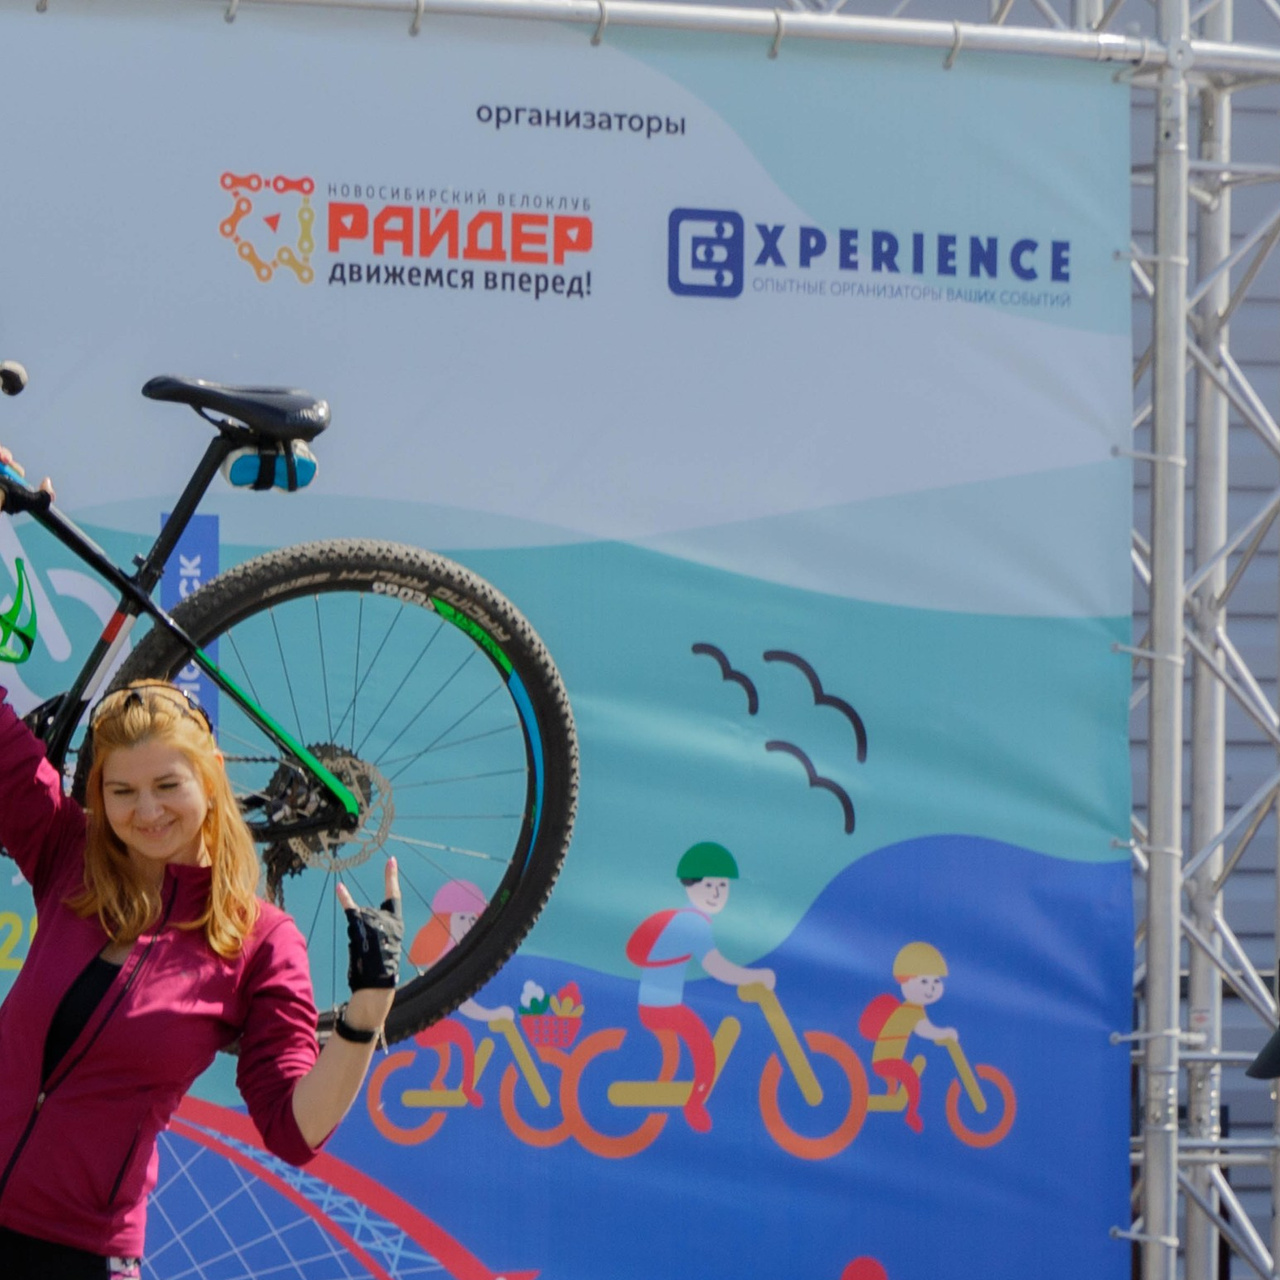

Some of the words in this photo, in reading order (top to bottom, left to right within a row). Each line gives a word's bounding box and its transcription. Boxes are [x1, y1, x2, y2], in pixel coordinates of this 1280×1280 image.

[476, 104, 685, 139] организаторы
[328, 183, 487, 205] НОВОСИБИРСКИЙ
[497, 193, 591, 211] ВЕЛОКЛУБ
[328, 202, 593, 265] РАЙДЕР
[329, 262, 474, 289] движемся
[485, 271, 592, 300] вперед!
[753, 277, 826, 295] ОПЫТНЫЕ
[830, 281, 942, 301] ОРГАНИЗАТОРЫ
[946, 287, 996, 304] ВАШИХ
[999, 289, 1072, 308] СОБЫТИЙ
